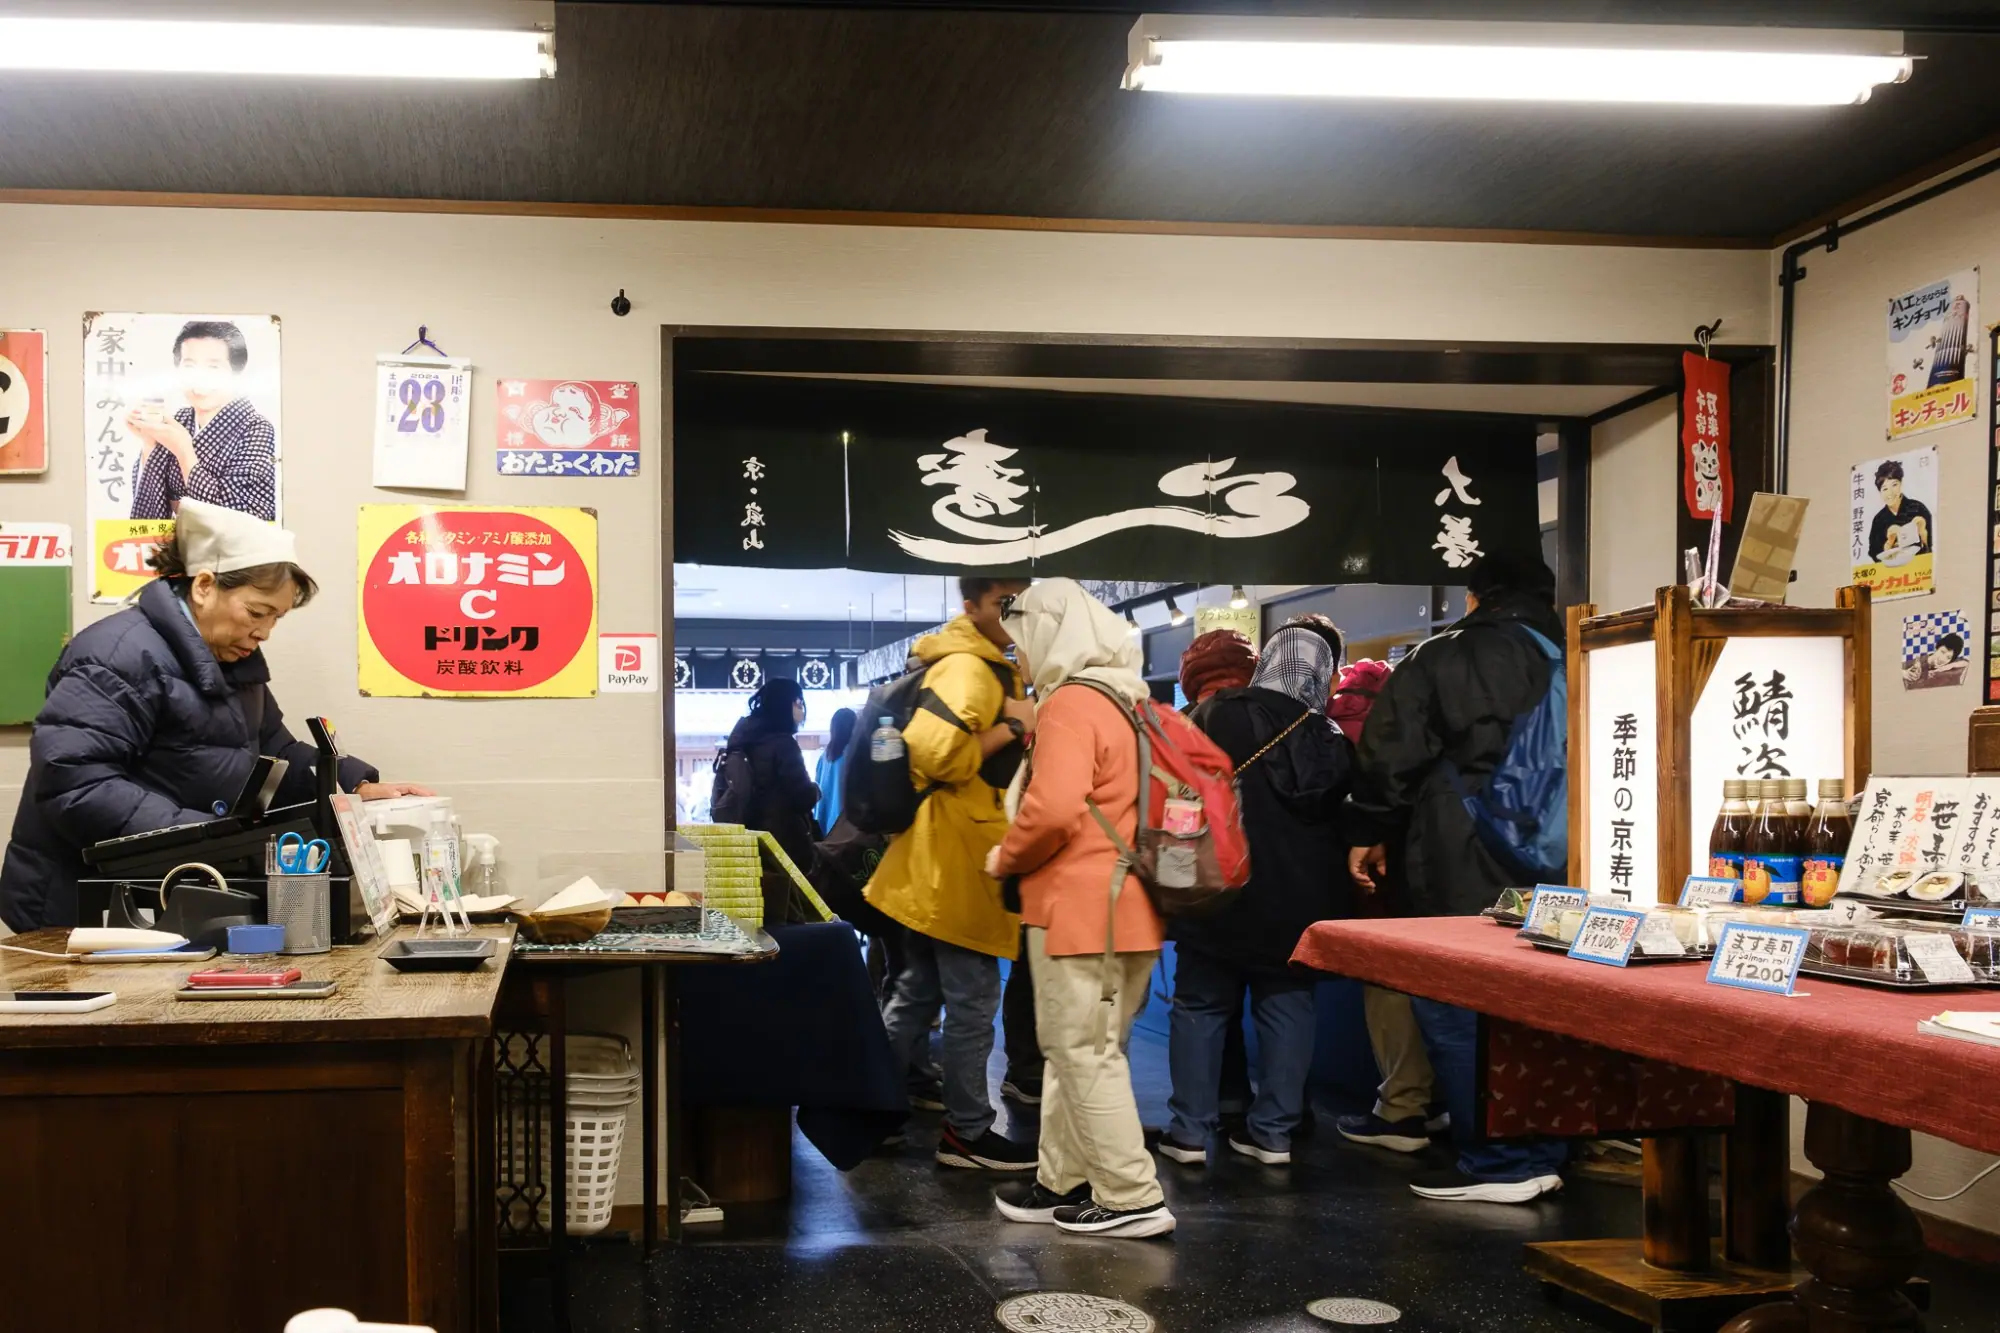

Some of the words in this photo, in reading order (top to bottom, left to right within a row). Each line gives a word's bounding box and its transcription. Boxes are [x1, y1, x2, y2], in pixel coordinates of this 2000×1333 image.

[1893, 299, 1950, 331] キンチョール
[397, 378, 446, 433] 23
[1894, 392, 1971, 428] キンチョール
[501, 451, 636, 475] おたふくわた
[1853, 473, 1865, 500] 牛肉
[387, 551, 566, 586] オロナミン
[459, 589, 497, 620] C
[424, 626, 539, 651] ドリンク
[436, 659, 524, 676] 炭酸飲料
[608, 673, 649, 686] PayPay
[1961, 792, 1991, 863] おすすめの
[1731, 932, 1793, 956] ます寿司
